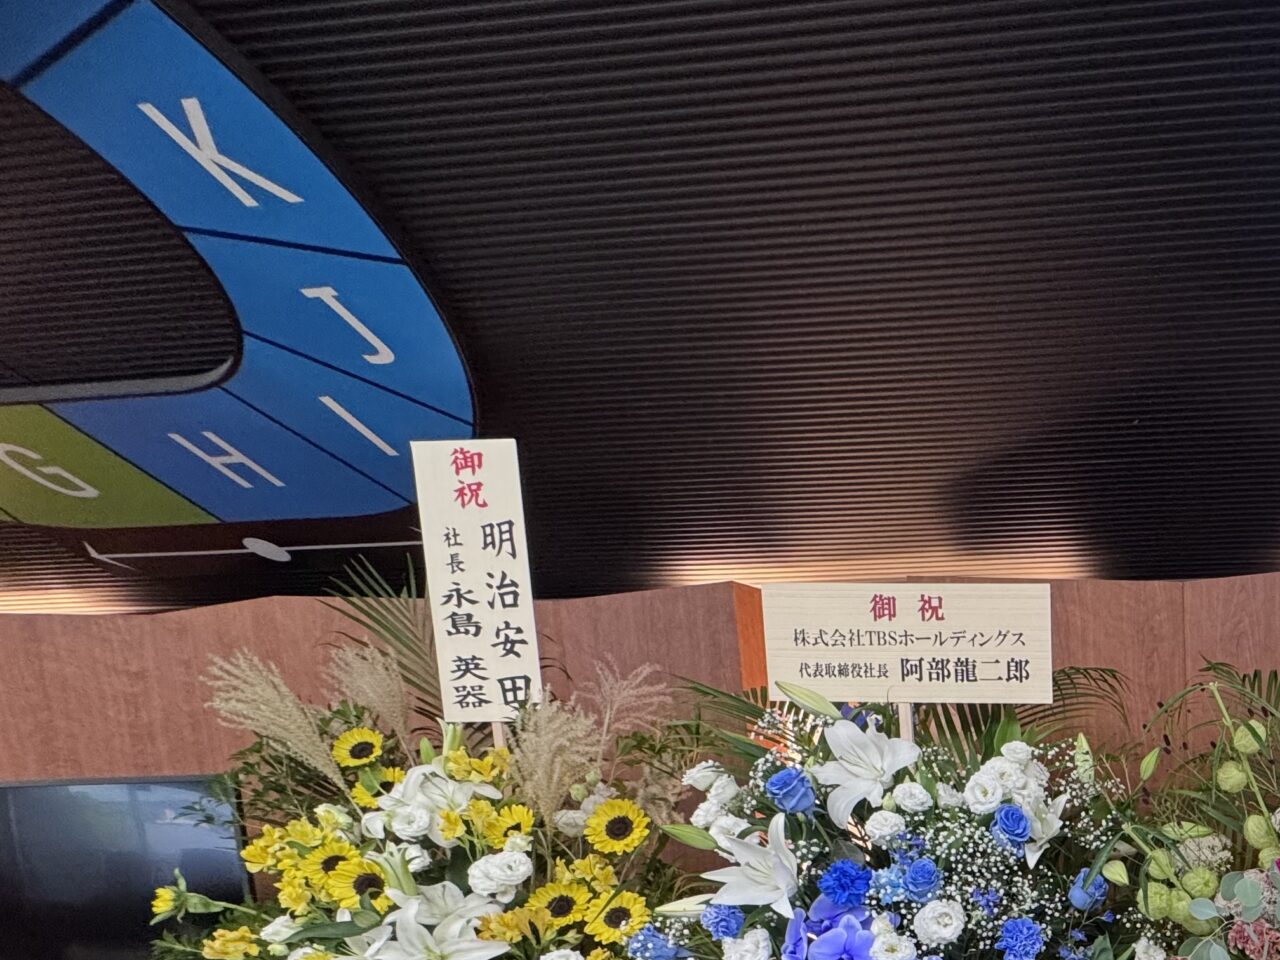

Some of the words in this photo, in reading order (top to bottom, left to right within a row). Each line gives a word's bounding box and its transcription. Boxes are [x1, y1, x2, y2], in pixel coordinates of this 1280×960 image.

[137, 97, 304, 207] K
[300, 286, 395, 364] J
[0, 443, 101, 498] G
[167, 431, 287, 489] H
[450, 447, 488, 509] 御祝
[480, 519, 532, 705] 明治安田
[793, 628, 1027, 648] 株式会社TBSホールディングス
[900, 657, 1031, 683] 阿部龍二郎
